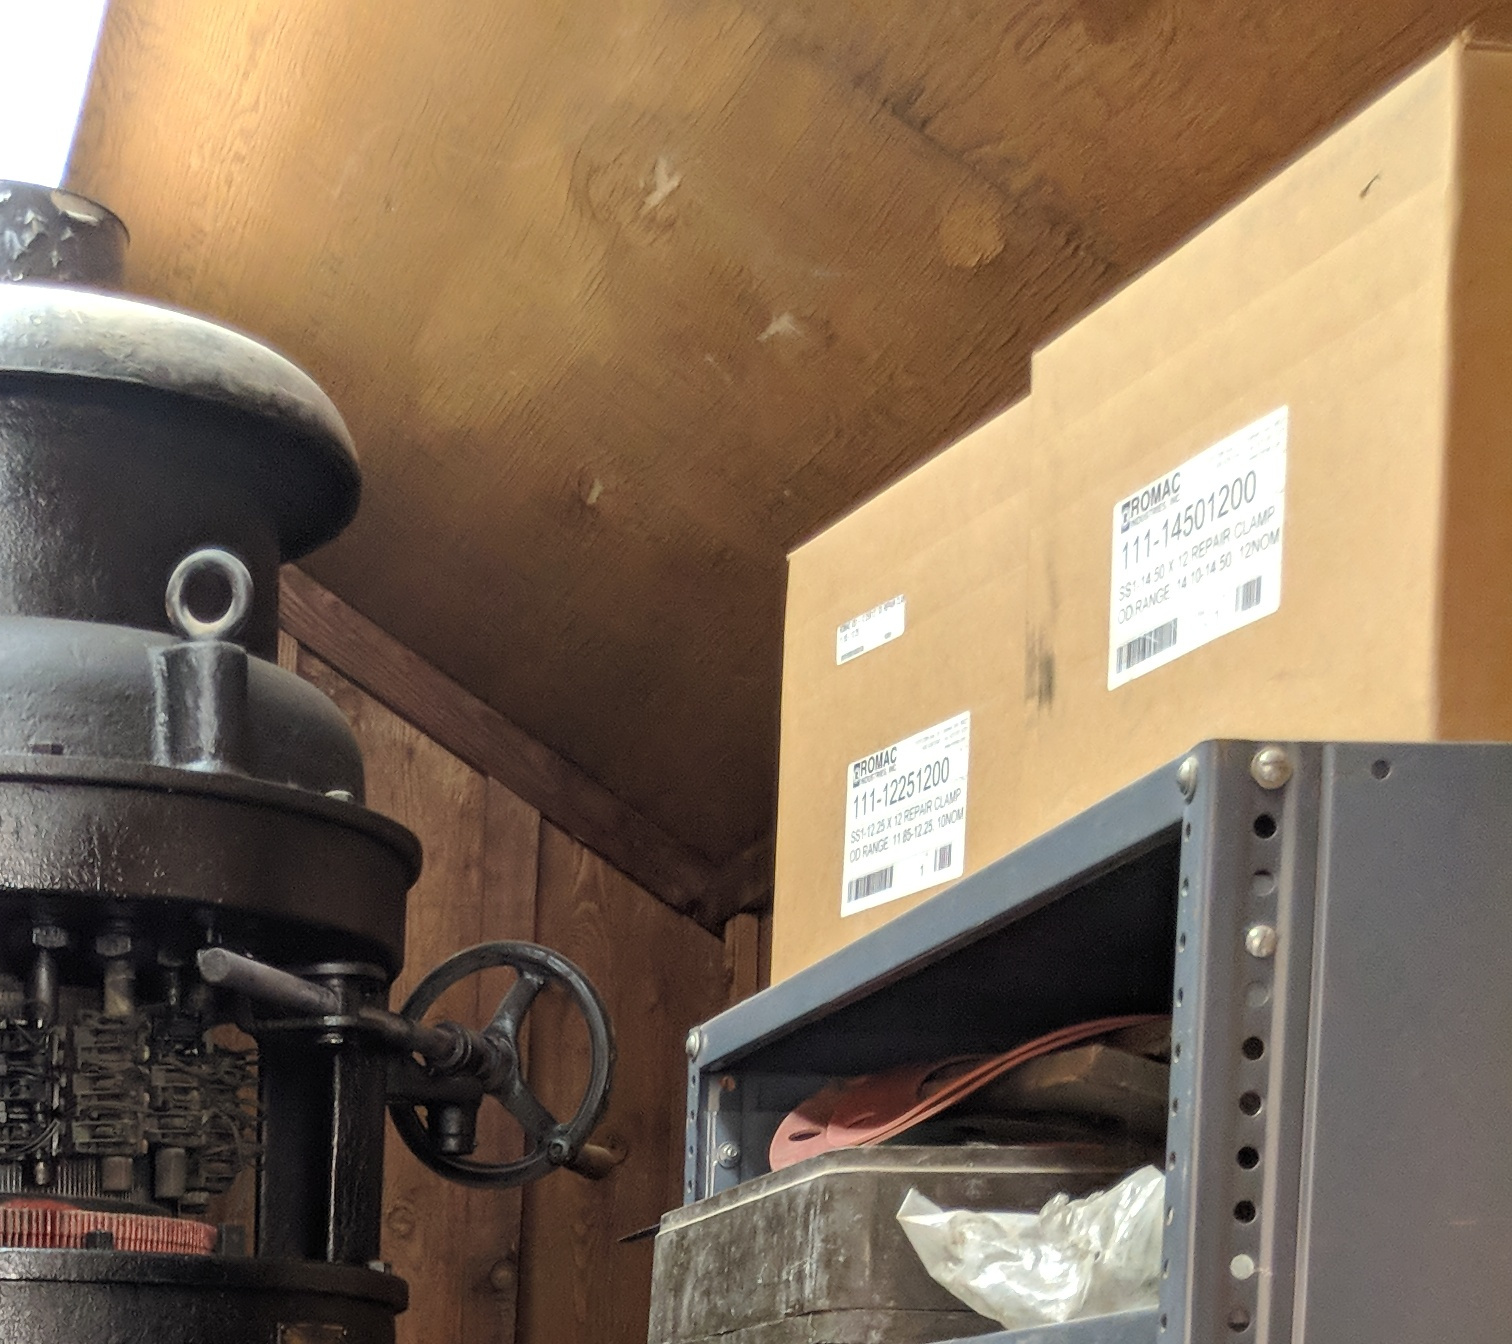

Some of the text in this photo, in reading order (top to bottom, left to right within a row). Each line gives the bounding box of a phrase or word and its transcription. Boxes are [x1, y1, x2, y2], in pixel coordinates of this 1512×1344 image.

[1122, 469, 1257, 569] 111-14501200
[1131, 471, 1181, 516] ROMAC
[1178, 551, 1189, 568] 12
[1191, 526, 1232, 559] REPAIR
[1234, 505, 1276, 539] CLAMP
[853, 756, 950, 819] 111-12251200
[859, 746, 898, 777] ROMAC
[894, 812, 903, 826] 12
[903, 799, 933, 822] REPAIR
[934, 787, 962, 811] CLAMP
